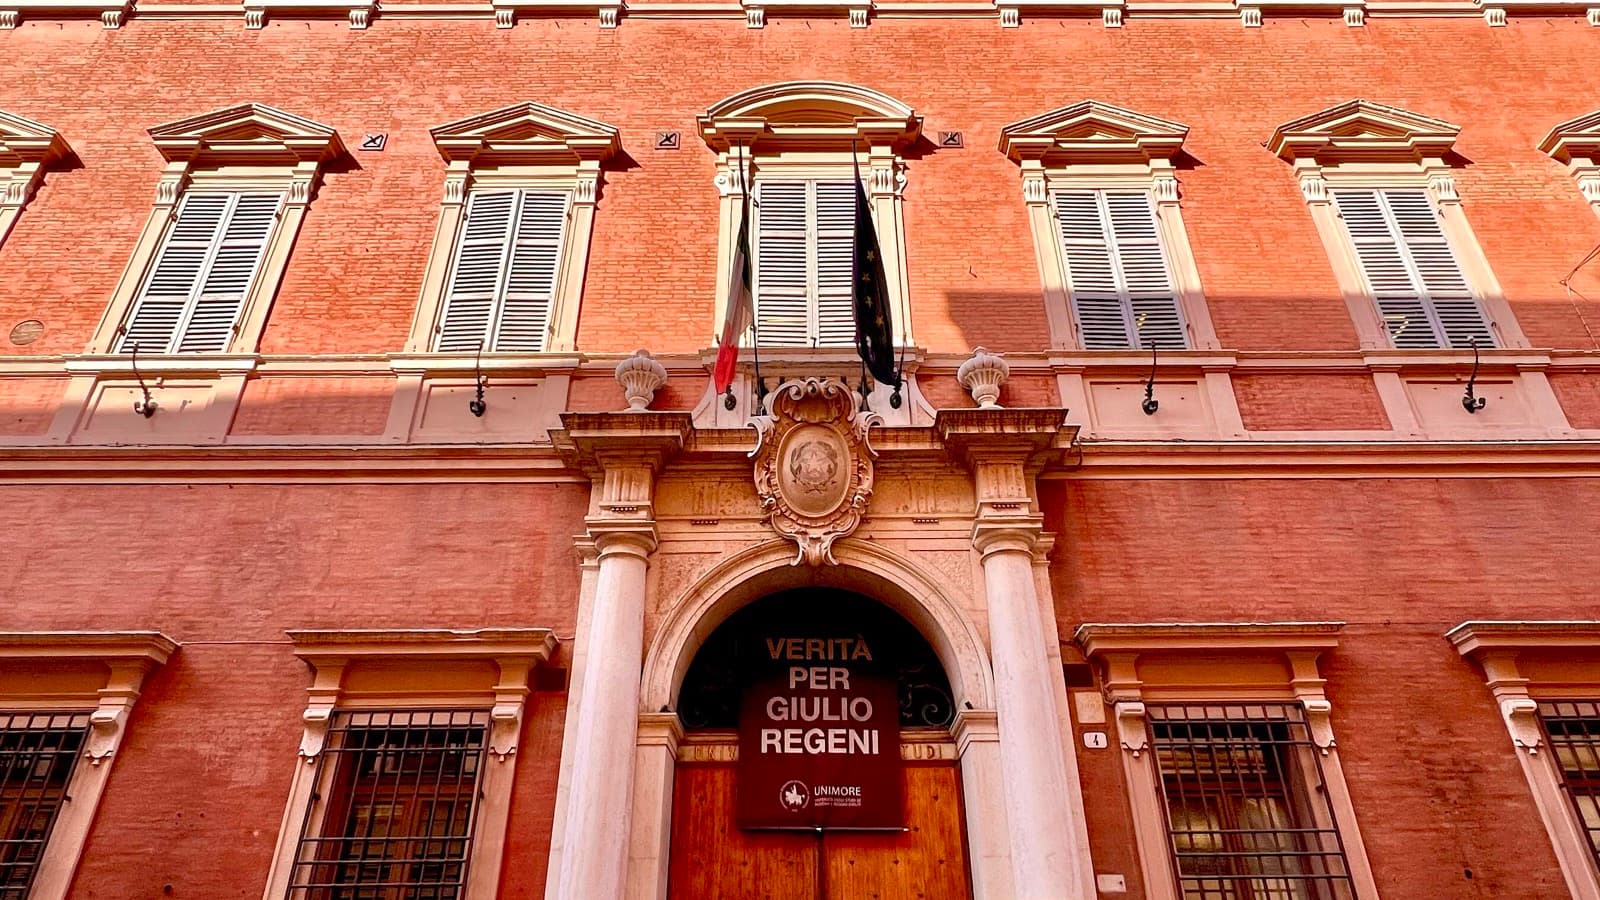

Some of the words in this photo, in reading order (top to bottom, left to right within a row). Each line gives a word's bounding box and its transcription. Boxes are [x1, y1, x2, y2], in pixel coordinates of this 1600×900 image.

[766, 634, 873, 661] VERITÀ
[789, 667, 850, 690] PER
[766, 696, 873, 722] GIULIO
[760, 728, 880, 755] REGENI
[1093, 734, 1099, 746] 4
[901, 744, 942, 760] TUDI
[814, 785, 862, 797] UNIMORE
